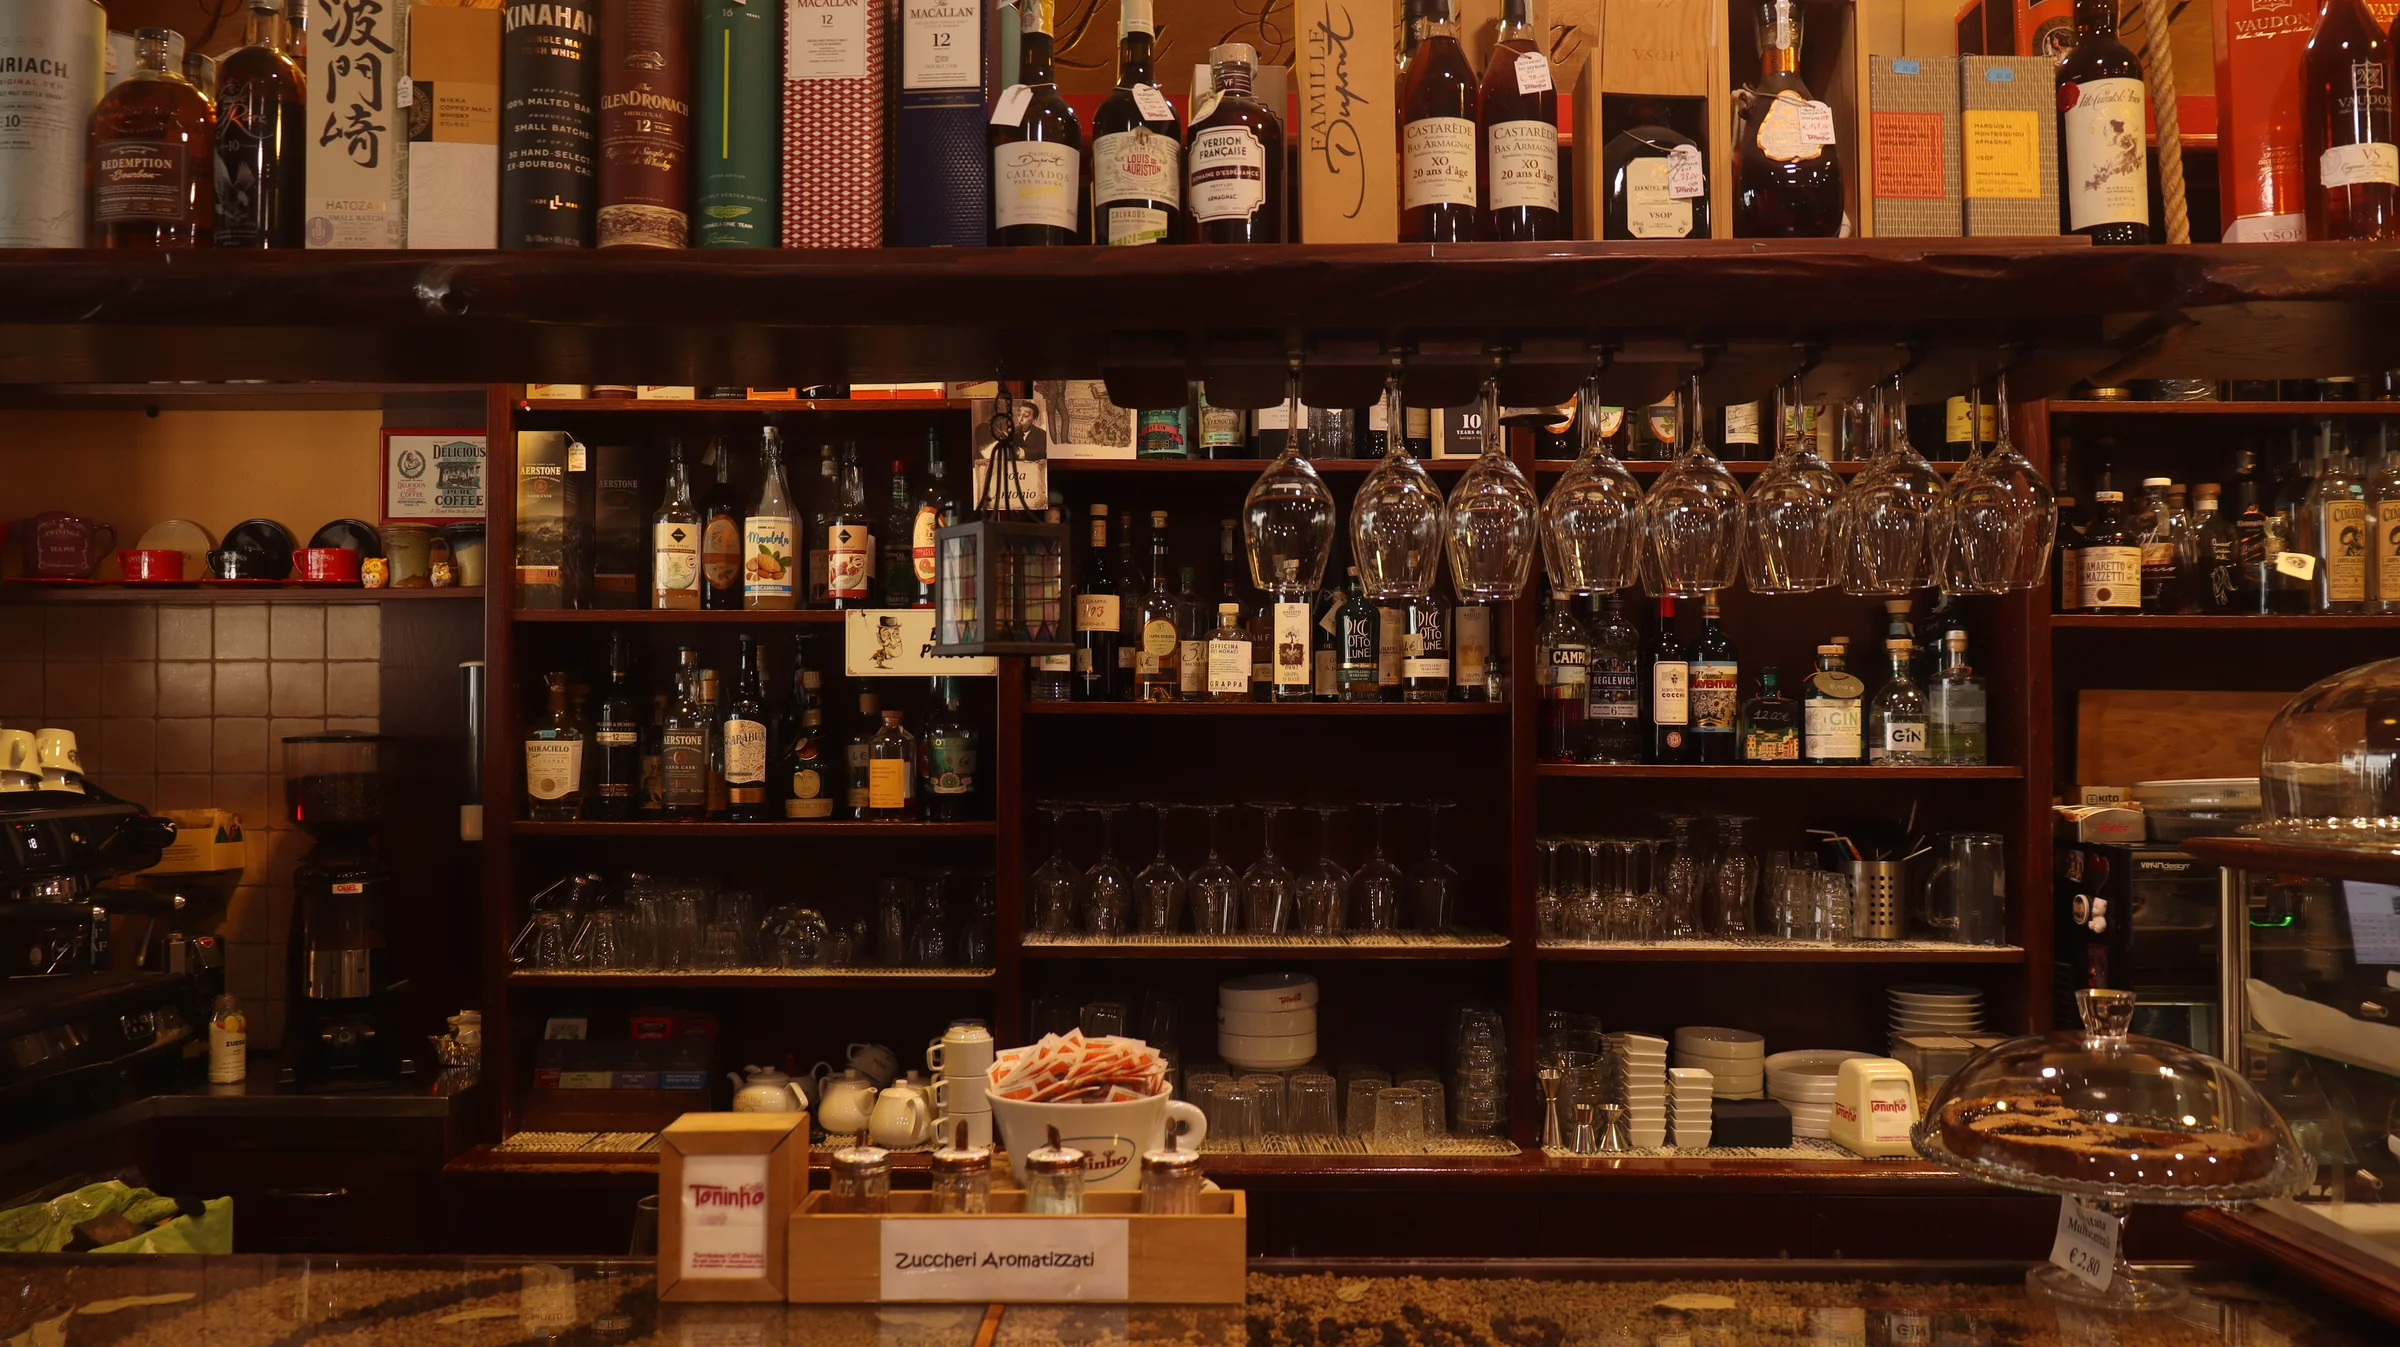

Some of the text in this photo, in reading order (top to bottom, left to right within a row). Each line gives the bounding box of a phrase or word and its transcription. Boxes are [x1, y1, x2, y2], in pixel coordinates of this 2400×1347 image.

[797, 0, 858, 8] MACALLAN
[722, 8, 734, 17] 16
[910, 7, 975, 19] MACALLAN
[822, 14, 833, 25] 12
[2235, 13, 2311, 33] VAUDON
[933, 33, 951, 47] 12
[1632, 48, 1680, 63] VSOP
[1310, 28, 1327, 153] FAMILLE
[472, 105, 492, 113] MALT
[527, 98, 570, 108] MALTED
[5, 115, 20, 127] 10
[624, 111, 664, 119] ORIGINAL
[514, 124, 547, 132] SMALL
[636, 120, 652, 132] 12
[1407, 122, 1473, 139] CASTARÈDE
[1494, 127, 1557, 142] CASTARÈDE
[228, 140, 240, 152] 10
[1202, 136, 1241, 149] VERSION
[1407, 140, 1473, 154] BAS ARMAGNAC
[1494, 142, 1557, 155] BAS ARMAGNAC
[508, 151, 518, 159] 30
[1127, 154, 1149, 164] LOUIS
[1200, 147, 1246, 160] FRANÇAISE
[2362, 148, 2381, 160] VS
[101, 157, 172, 170] REDEMPTION
[507, 161, 571, 171] EX-BOURBON
[1431, 156, 1449, 166] XO
[1522, 159, 1539, 168] XO
[1123, 164, 1161, 176] LAURISTON
[1413, 165, 1469, 179] 20 ans d'âge
[1006, 170, 1070, 183] CALVADOS
[1501, 170, 1514, 179] 20
[1536, 170, 1554, 183] d'âge
[1208, 193, 1238, 202] ARMAGNAC
[1111, 210, 1146, 219] CALVADOS
[2262, 229, 2302, 242] VSOP
[1462, 413, 1481, 429] 10
[433, 444, 486, 459] DELICIOUS
[520, 466, 562, 476] AERSTONE
[598, 479, 638, 489] AERSTONE
[435, 496, 483, 506] COFFEE
[2086, 561, 2125, 571] AMARETTO
[2086, 571, 2125, 582] MAZZETTI
[1419, 640, 1443, 651] LUNE
[1346, 648, 1372, 659] LUNE
[1209, 680, 1243, 688] GRAPPA
[1593, 676, 1635, 685] KEGLEVICH
[1611, 706, 1618, 716] 6
[1830, 711, 1858, 726] GIN
[663, 735, 703, 745] AERSTONE
[528, 745, 569, 753] MIRACIELO
[1870, 1100, 1907, 1113] Toninho
[689, 1184, 765, 1209] Toninho
[895, 1251, 1095, 1269] Zuccheri Aromatizzati
[2069, 1247, 2079, 1263] €
